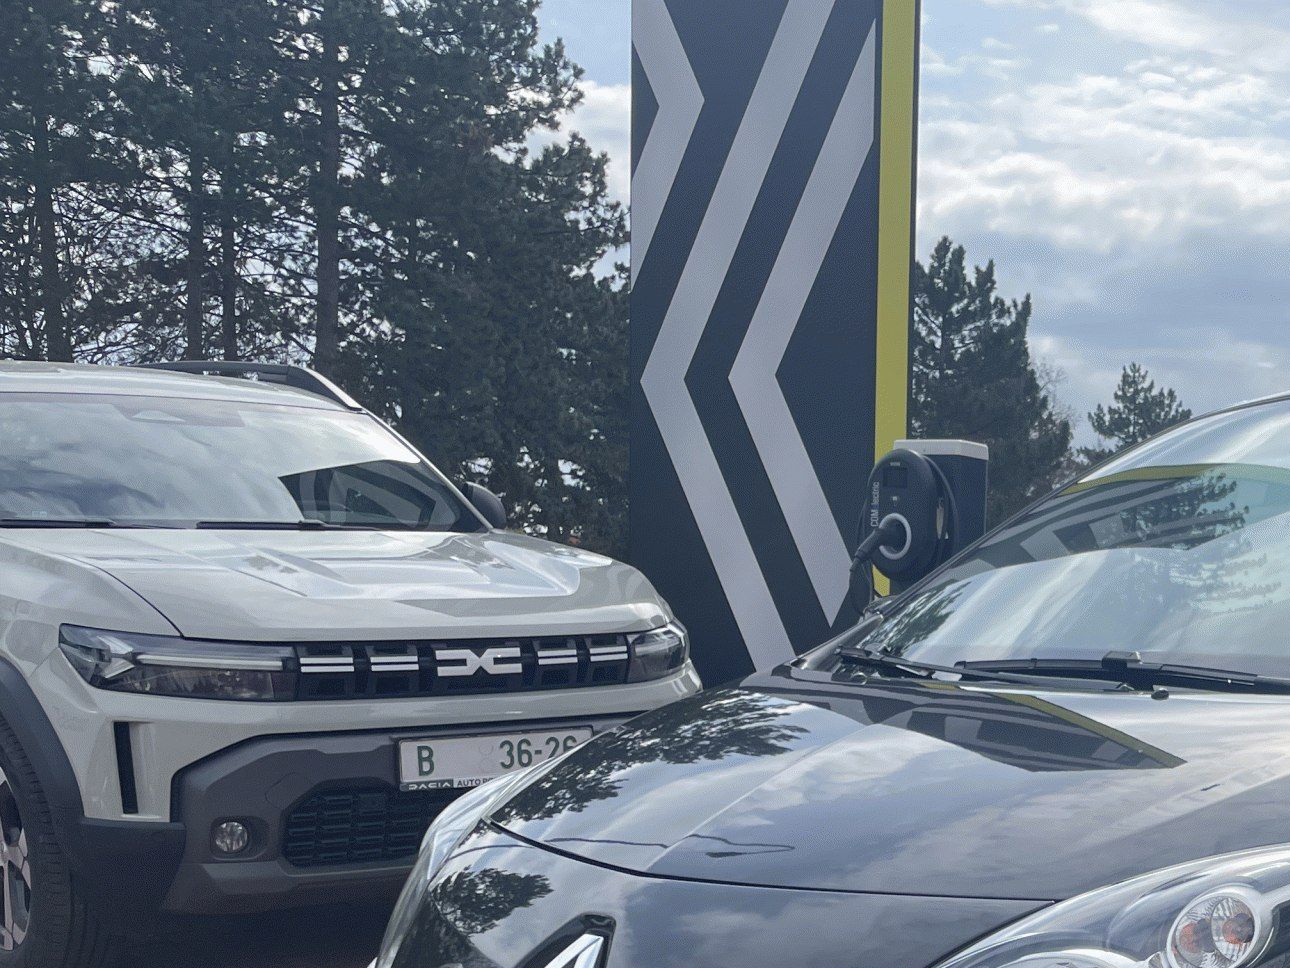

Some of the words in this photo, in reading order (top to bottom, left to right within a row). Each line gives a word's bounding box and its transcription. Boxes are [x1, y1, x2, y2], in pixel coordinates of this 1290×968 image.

[417, 745, 435, 777] B
[408, 781, 451, 790] DACIA
[457, 778, 481, 788] AUTO
